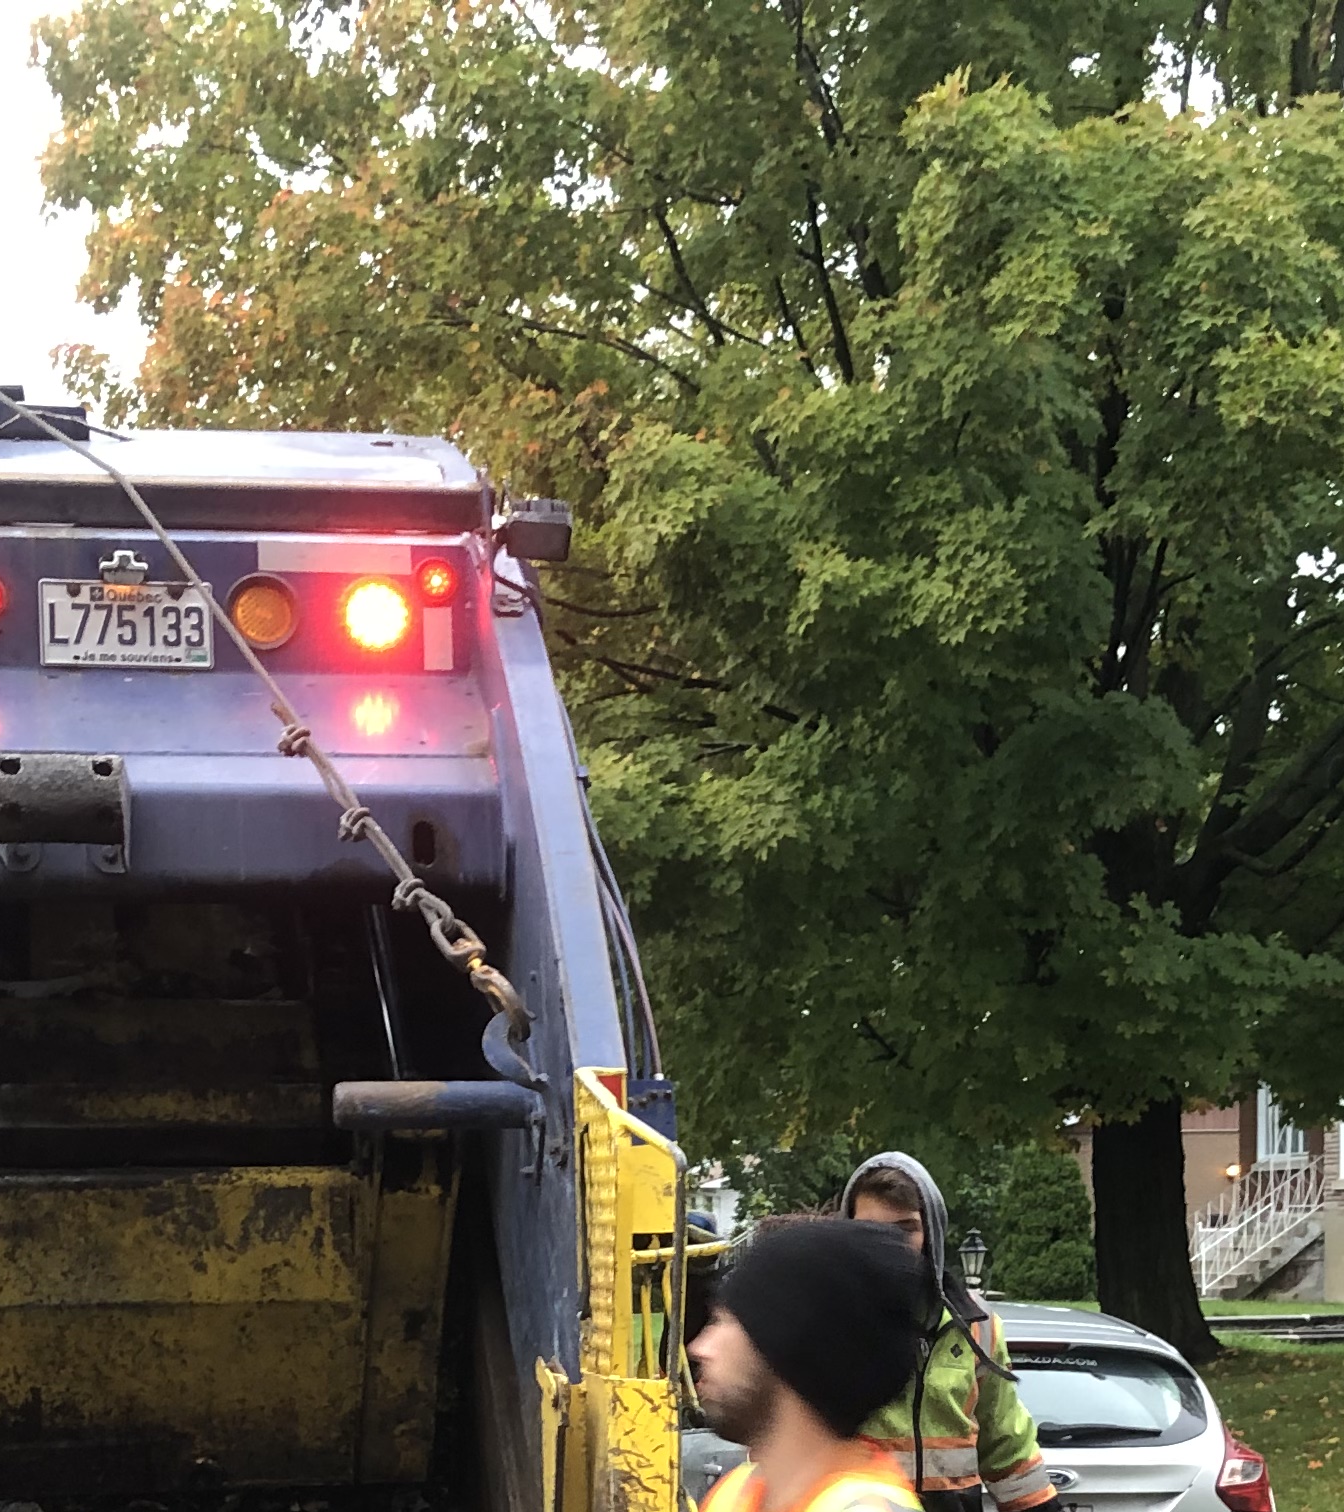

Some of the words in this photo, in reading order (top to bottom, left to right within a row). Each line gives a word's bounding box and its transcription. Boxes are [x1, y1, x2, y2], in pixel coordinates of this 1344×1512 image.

[106, 588, 163, 603] Québec
[48, 602, 205, 647] L775133
[81, 650, 96, 662] Je
[98, 652, 118, 662] me
[120, 651, 174, 663] souviens
